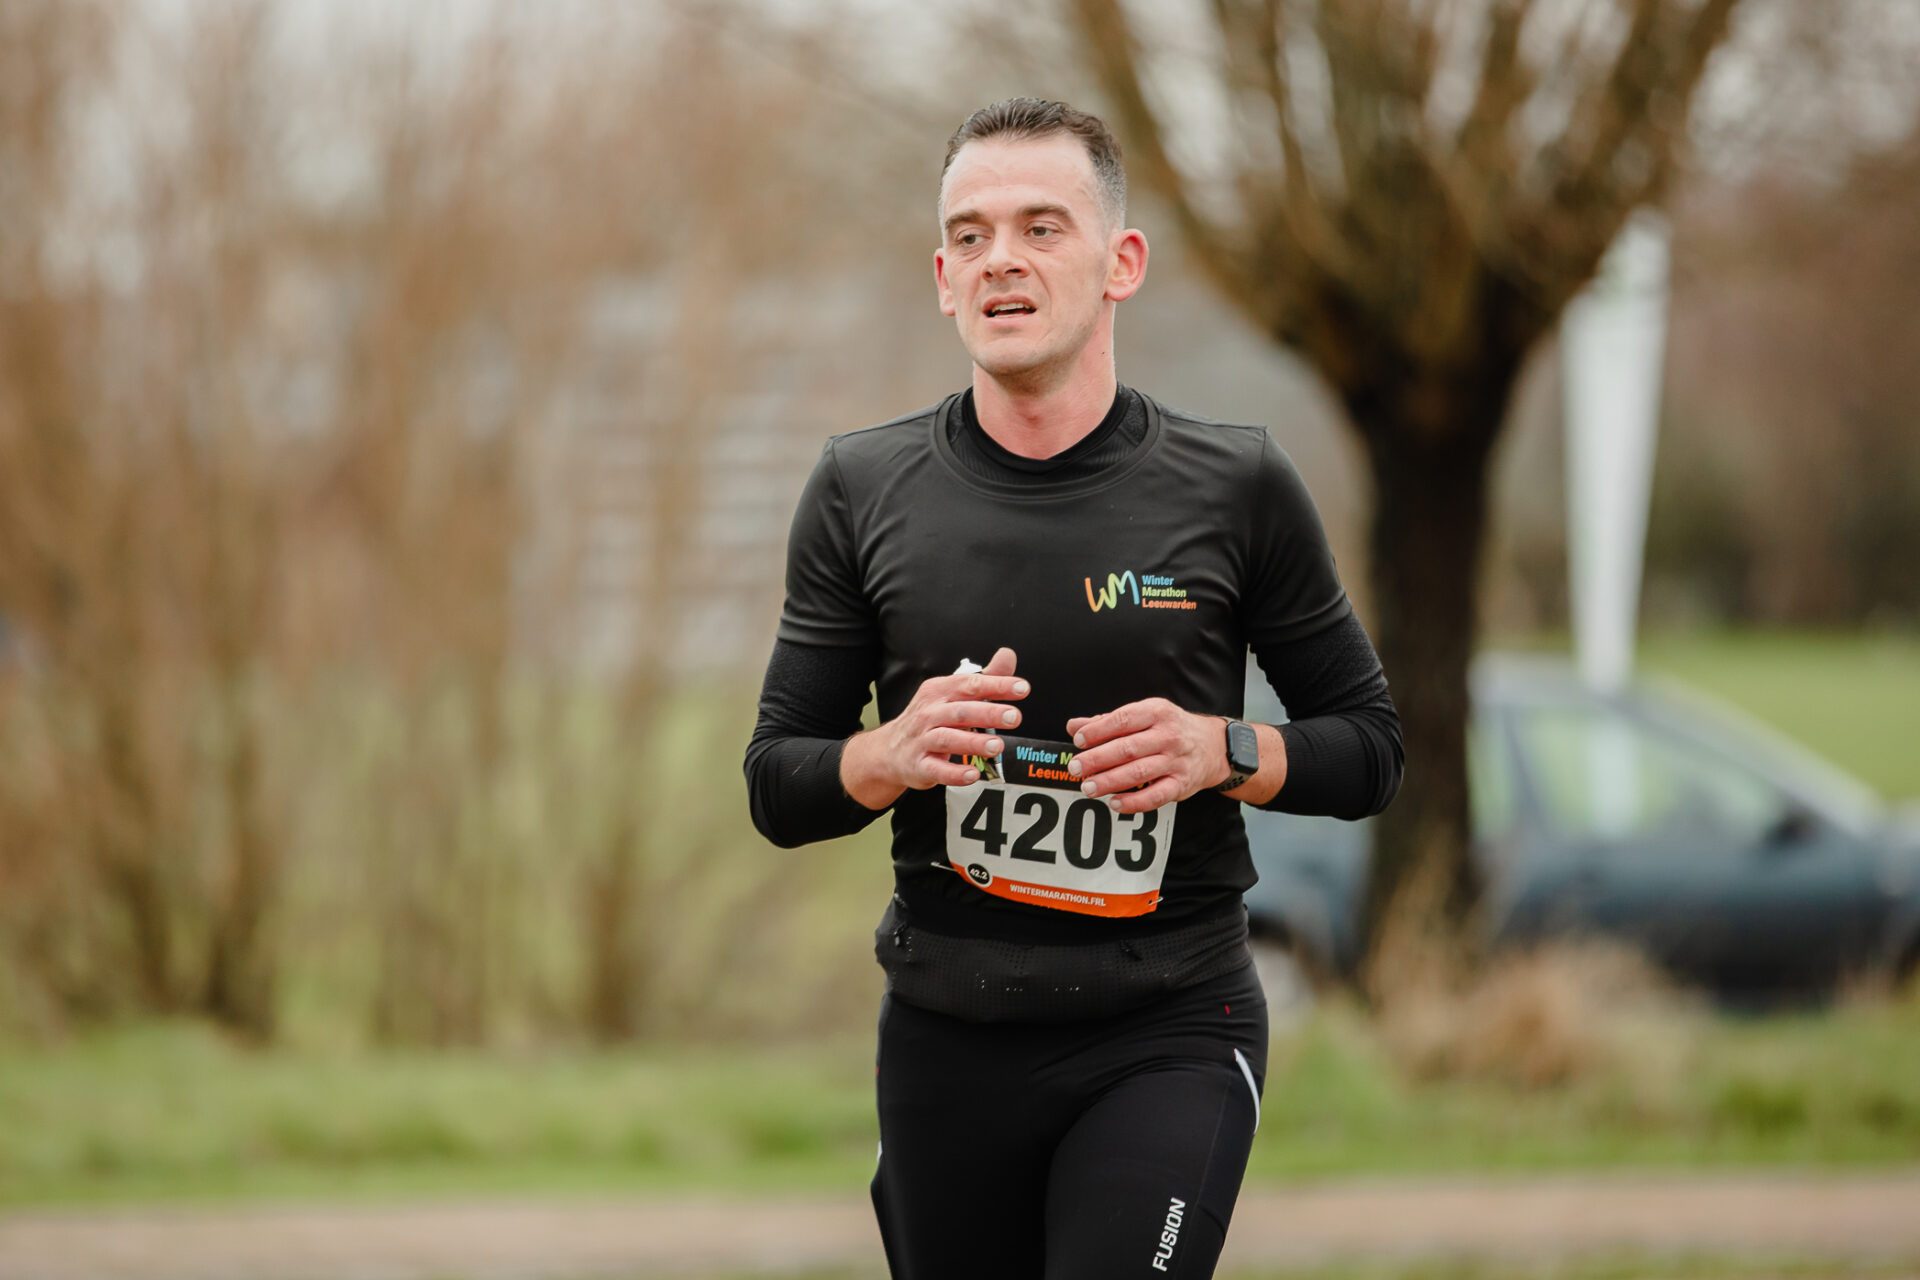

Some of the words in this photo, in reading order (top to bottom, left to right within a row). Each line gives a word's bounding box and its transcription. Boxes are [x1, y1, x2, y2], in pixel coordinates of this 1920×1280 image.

[1142, 575, 1174, 585] Winter
[1142, 587, 1187, 597] Marathon
[1142, 598, 1197, 610] Leeuwarden
[1016, 746, 1058, 764] Winter
[960, 788, 1159, 872] 4203
[1010, 884, 1106, 907] WINTERMARATHON.FRL
[1152, 1197, 1186, 1272] FUSION
